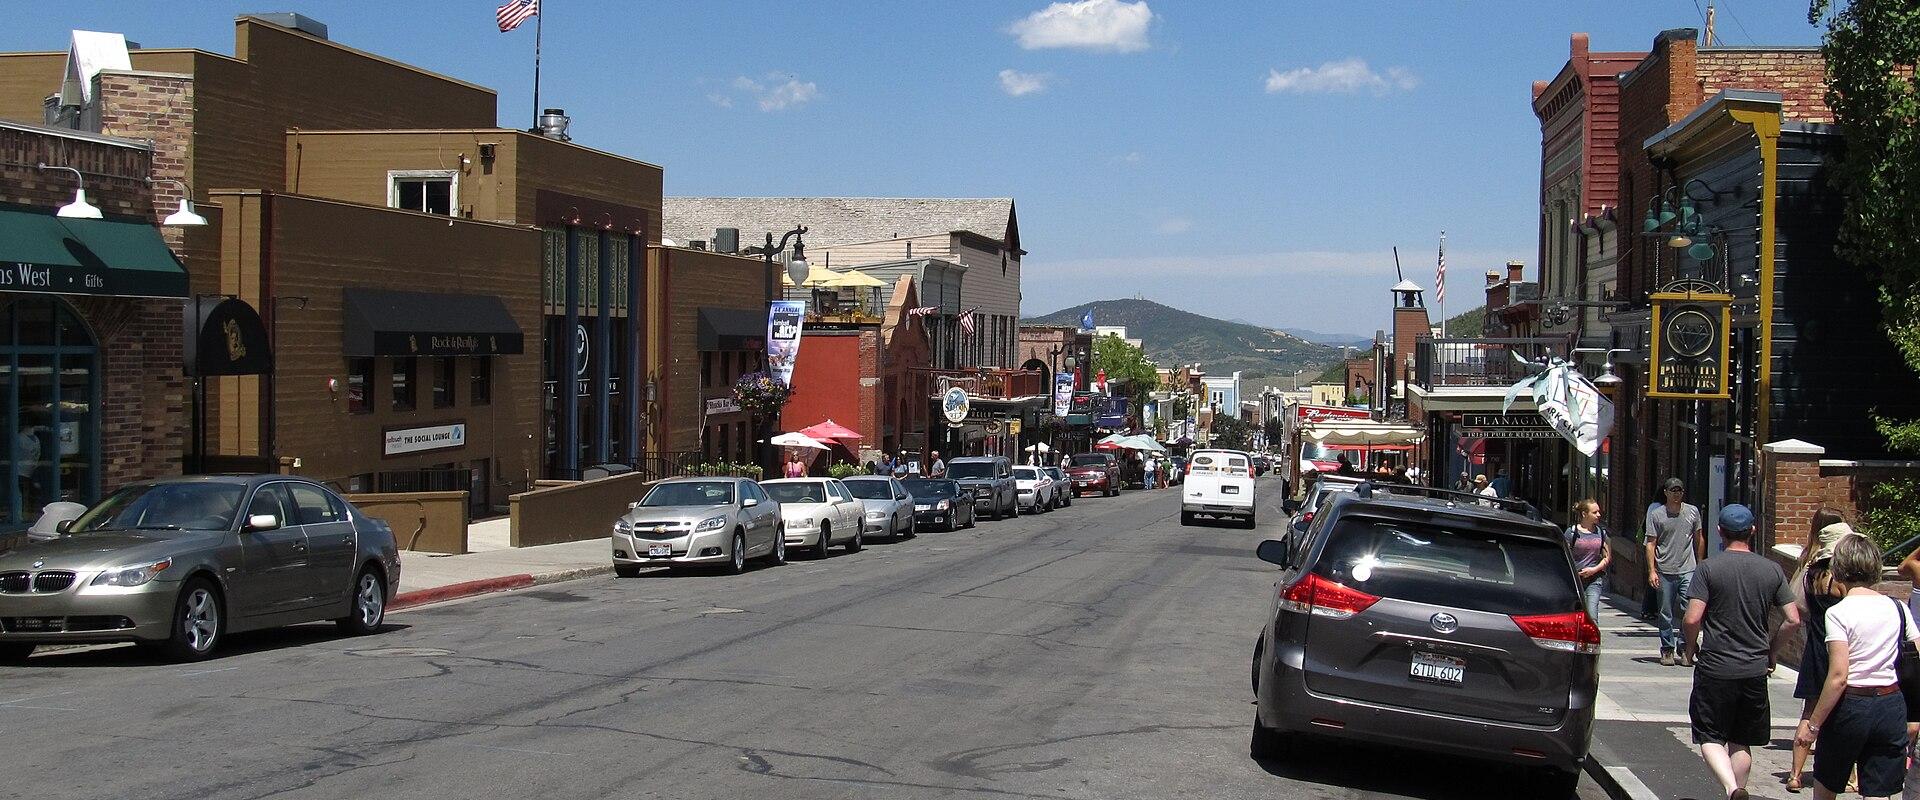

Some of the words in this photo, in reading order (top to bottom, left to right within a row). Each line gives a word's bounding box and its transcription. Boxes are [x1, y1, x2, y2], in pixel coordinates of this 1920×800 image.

[18, 263, 50, 287] West
[85, 273, 103, 288] Gifts
[1660, 365, 1691, 375] PARK
[414, 434, 431, 443] SOCIAL
[432, 432, 451, 441] LOUNGE
[1412, 662, 1461, 682] 6TDL602
